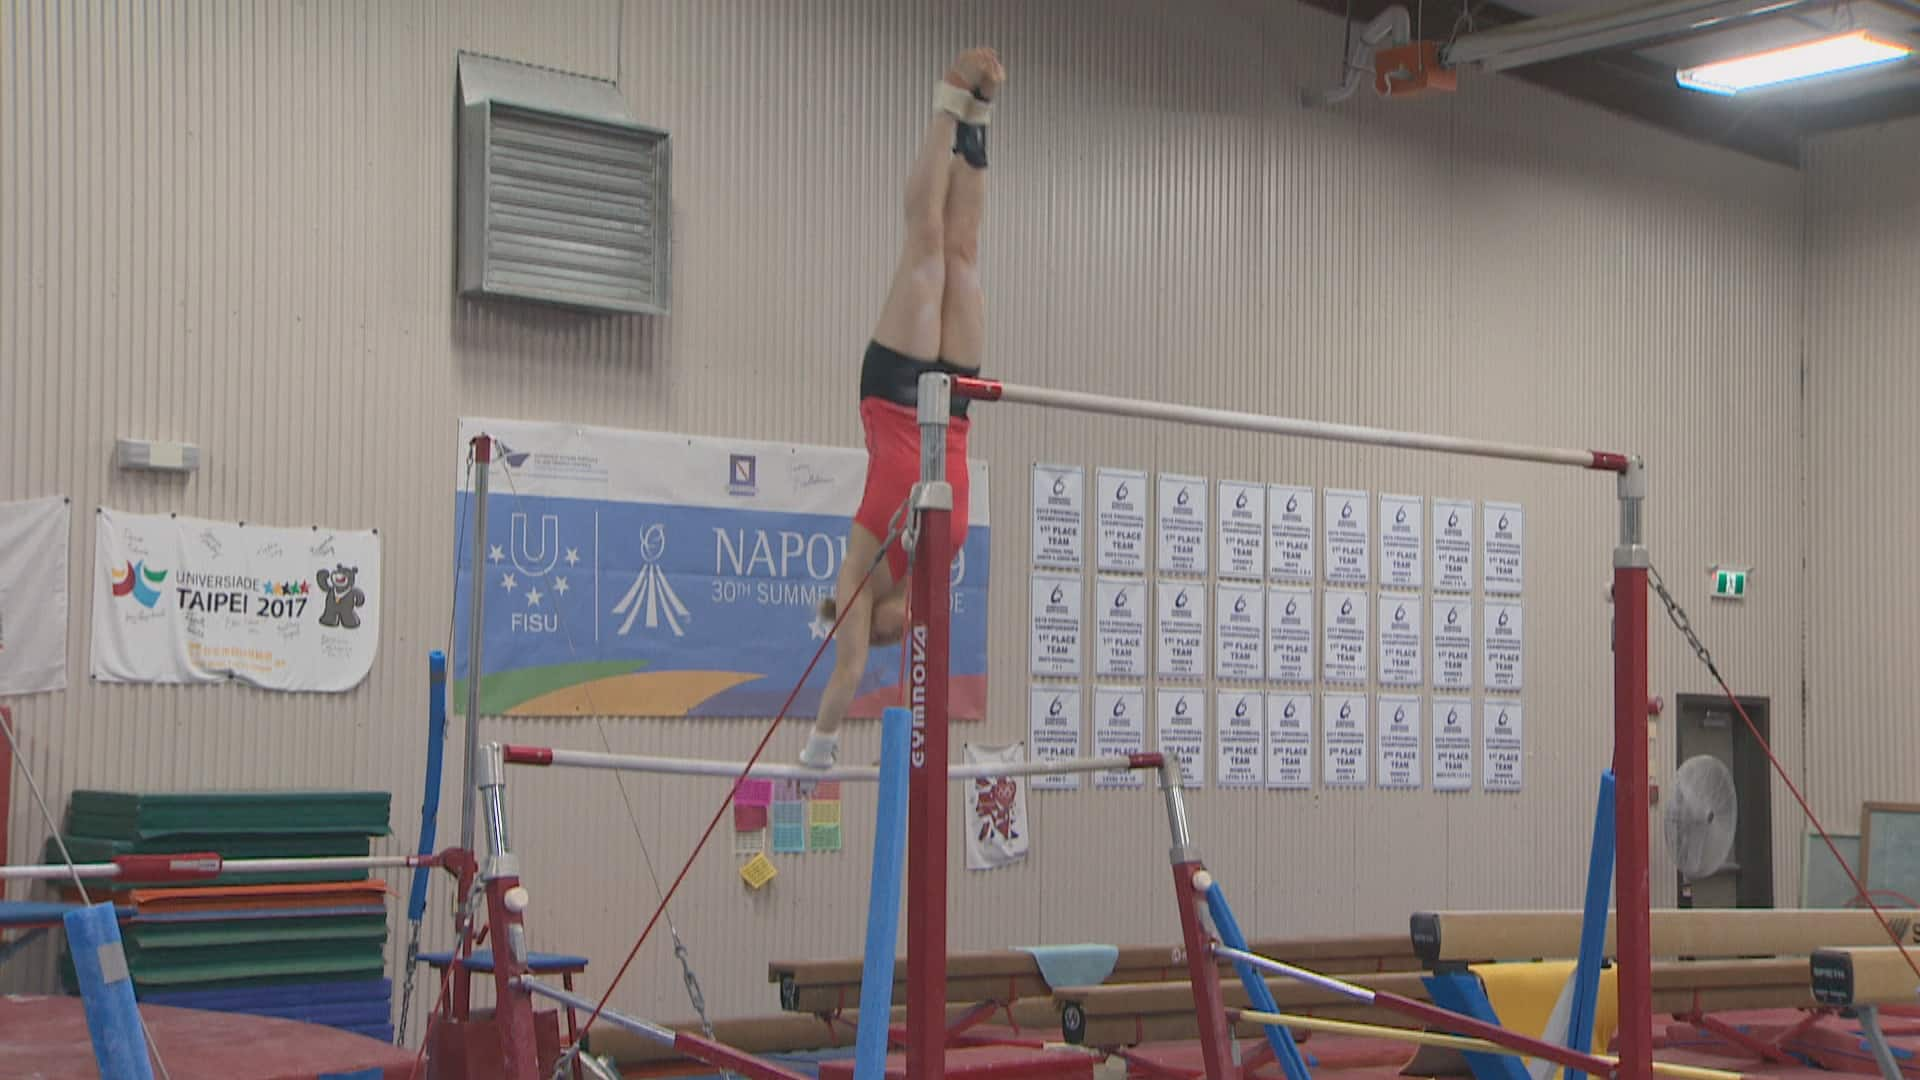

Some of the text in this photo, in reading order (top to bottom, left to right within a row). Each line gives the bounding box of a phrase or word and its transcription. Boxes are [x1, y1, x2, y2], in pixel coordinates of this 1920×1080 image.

[1053, 526, 1077, 536] PLACE
[1117, 531, 1141, 540] PLACE
[1048, 537, 1070, 546] TEAM
[1177, 535, 1200, 544] PLACE
[1237, 537, 1259, 547] PLACE
[1113, 542, 1133, 550] TEAM
[1173, 546, 1193, 554] TEAM
[1287, 541, 1308, 550] PLACE
[712, 527, 846, 580] NAPO
[1233, 548, 1252, 557] TEAM
[1282, 552, 1301, 560] TEAM
[1343, 547, 1363, 556] PLACE
[1397, 551, 1416, 560] PLACE
[1339, 556, 1357, 565] TEAM
[1449, 555, 1468, 564] PLACE
[1500, 557, 1518, 566] PLACE
[1393, 561, 1410, 569] TEAM
[1445, 564, 1462, 572] TEAM
[1496, 567, 1512, 575] TEAM
[176, 570, 260, 592] UNIVERSIADE
[176, 588, 308, 618] TAIPEI 2017
[511, 613, 559, 633] FISU
[1051, 635, 1075, 645] PLACE
[1115, 638, 1139, 647] PLACE
[1177, 638, 1199, 647] PLACE
[1047, 645, 1068, 654] TEAM
[1235, 642, 1257, 651] PLACE
[1286, 644, 1308, 654] PLACE
[1341, 643, 1361, 653] PLACE
[1111, 649, 1132, 657] TEAM
[1231, 652, 1250, 660] TEAM
[1337, 653, 1355, 662] TEAM
[1396, 649, 1416, 658] PLACE
[1448, 651, 1468, 660] PLACE
[1282, 654, 1301, 663] TEAM
[1392, 658, 1409, 667] TEAM
[1500, 654, 1519, 662] PLACE
[1445, 660, 1462, 669] TEAM
[1496, 663, 1512, 671] TEAM
[1051, 747, 1075, 756] PLACE
[1177, 746, 1199, 755] PLACE
[1235, 747, 1257, 756] PLACE
[1285, 747, 1307, 756] PLACE
[1341, 747, 1362, 756] PLACE
[1395, 751, 1415, 760] PLACE
[1449, 752, 1468, 761] PLACE
[1498, 753, 1518, 762] PLACE
[1231, 757, 1249, 765] TEAM
[1281, 758, 1300, 766] TEAM
[1336, 758, 1355, 766] TEAM
[1391, 761, 1409, 769] TEAM
[1445, 762, 1462, 770] TEAM
[1496, 763, 1512, 771] TEAM
